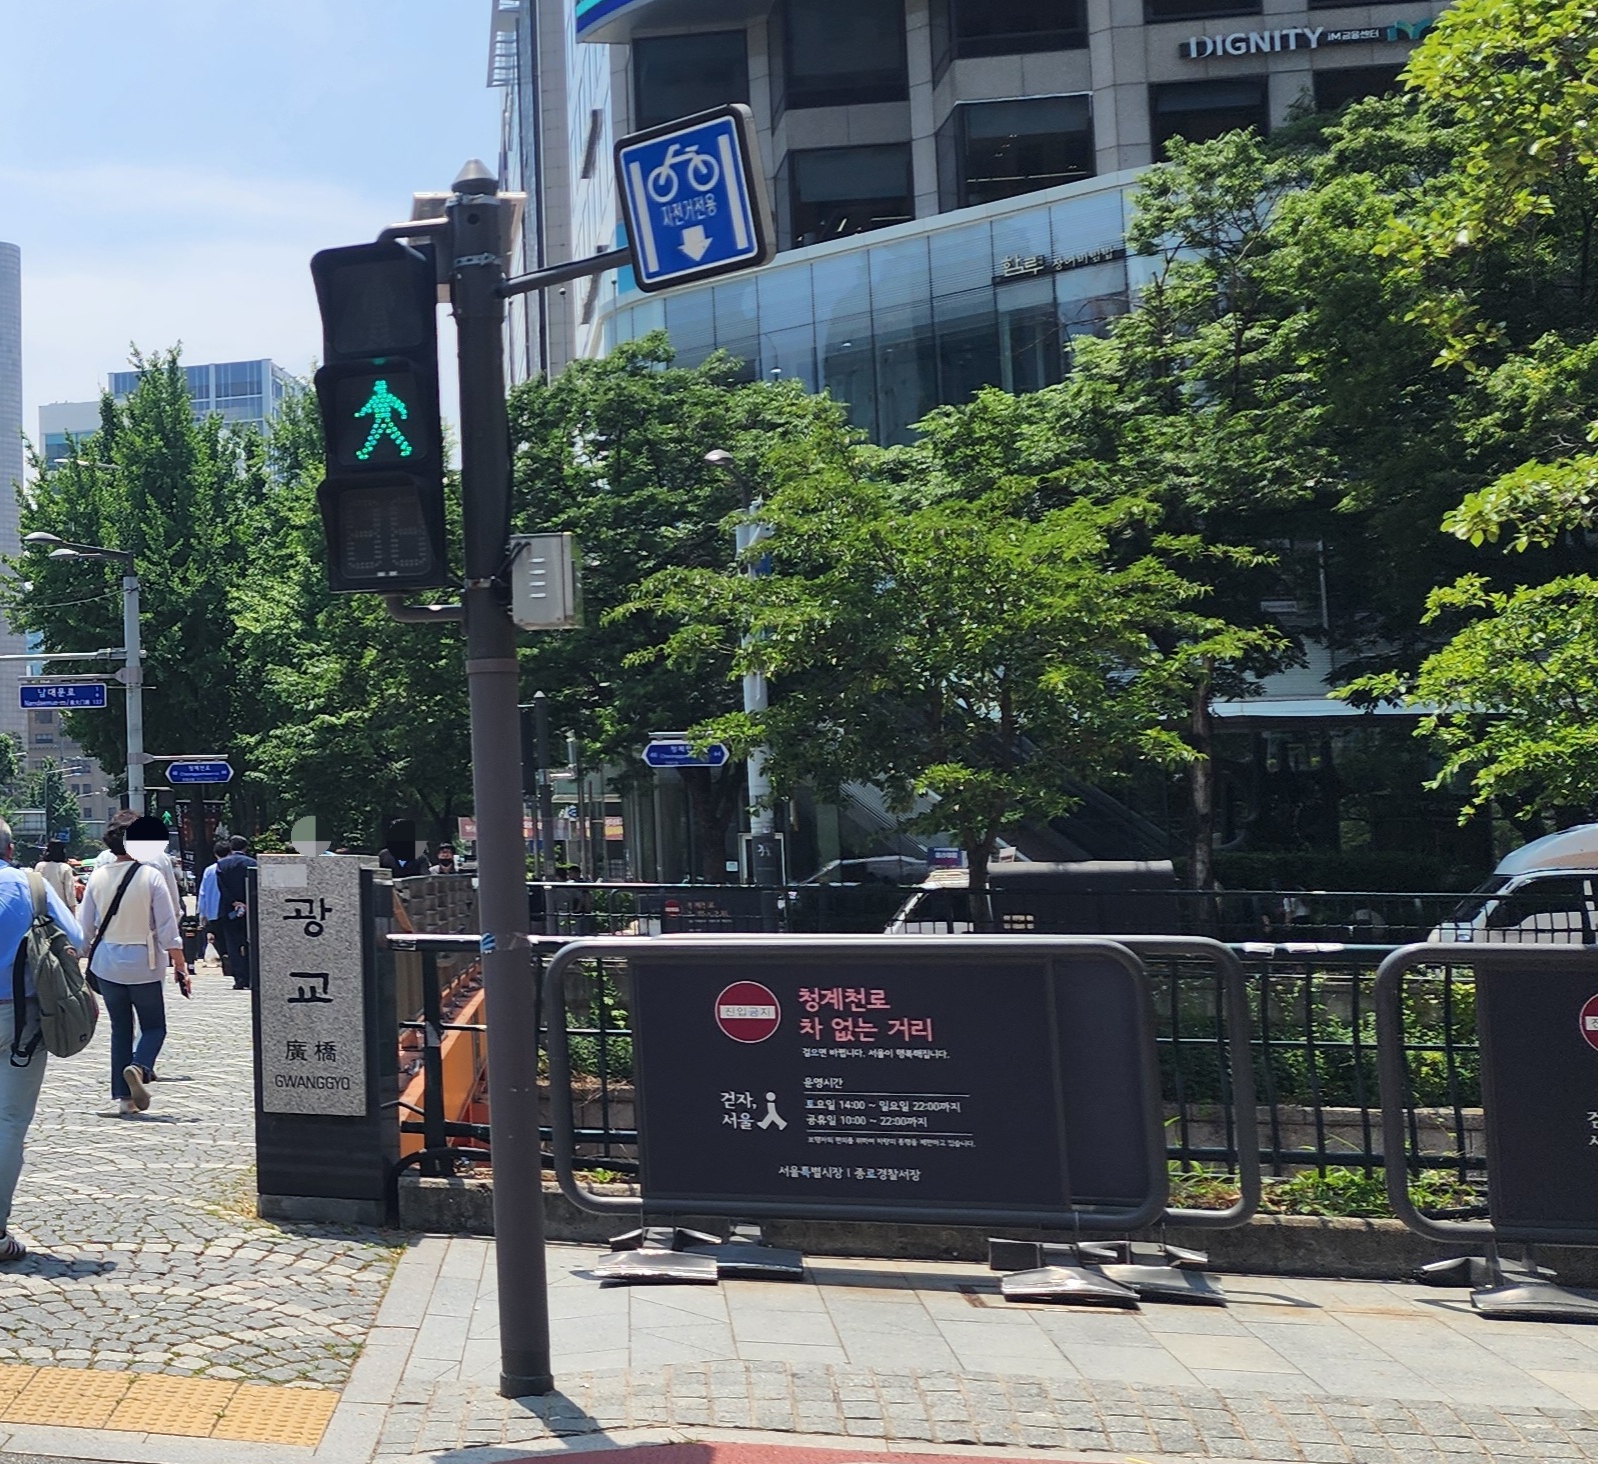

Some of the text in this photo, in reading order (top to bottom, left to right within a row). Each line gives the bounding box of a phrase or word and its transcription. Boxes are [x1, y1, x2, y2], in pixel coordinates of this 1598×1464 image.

[1189, 26, 1324, 58] DIGNITY
[661, 193, 717, 226] 자전거전용
[36, 687, 76, 698] 남대문로
[798, 987, 891, 1012] 청계천로
[799, 1018, 934, 1042] 차 없는 거리
[284, 1038, 337, 1064] 廣橋
[802, 1047, 827, 1058] 걸으면
[868, 1048, 894, 1059] 서울이
[274, 1074, 351, 1091] GWANGGYO
[803, 1077, 844, 1089] 운영시간
[720, 1091, 757, 1110] 걷자,
[805, 1099, 836, 1110] 토요일
[839, 1100, 866, 1110] 14:00
[878, 1101, 910, 1112] 일요일
[913, 1101, 961, 1113] 22:00까지
[721, 1112, 754, 1130] 서울
[806, 1114, 837, 1126] 공휴일
[839, 1115, 867, 1125] 10:00
[880, 1116, 928, 1127] 22:00까지
[778, 1165, 843, 1179] 서울특별시장
[854, 1167, 921, 1182] 종로경찰서장
